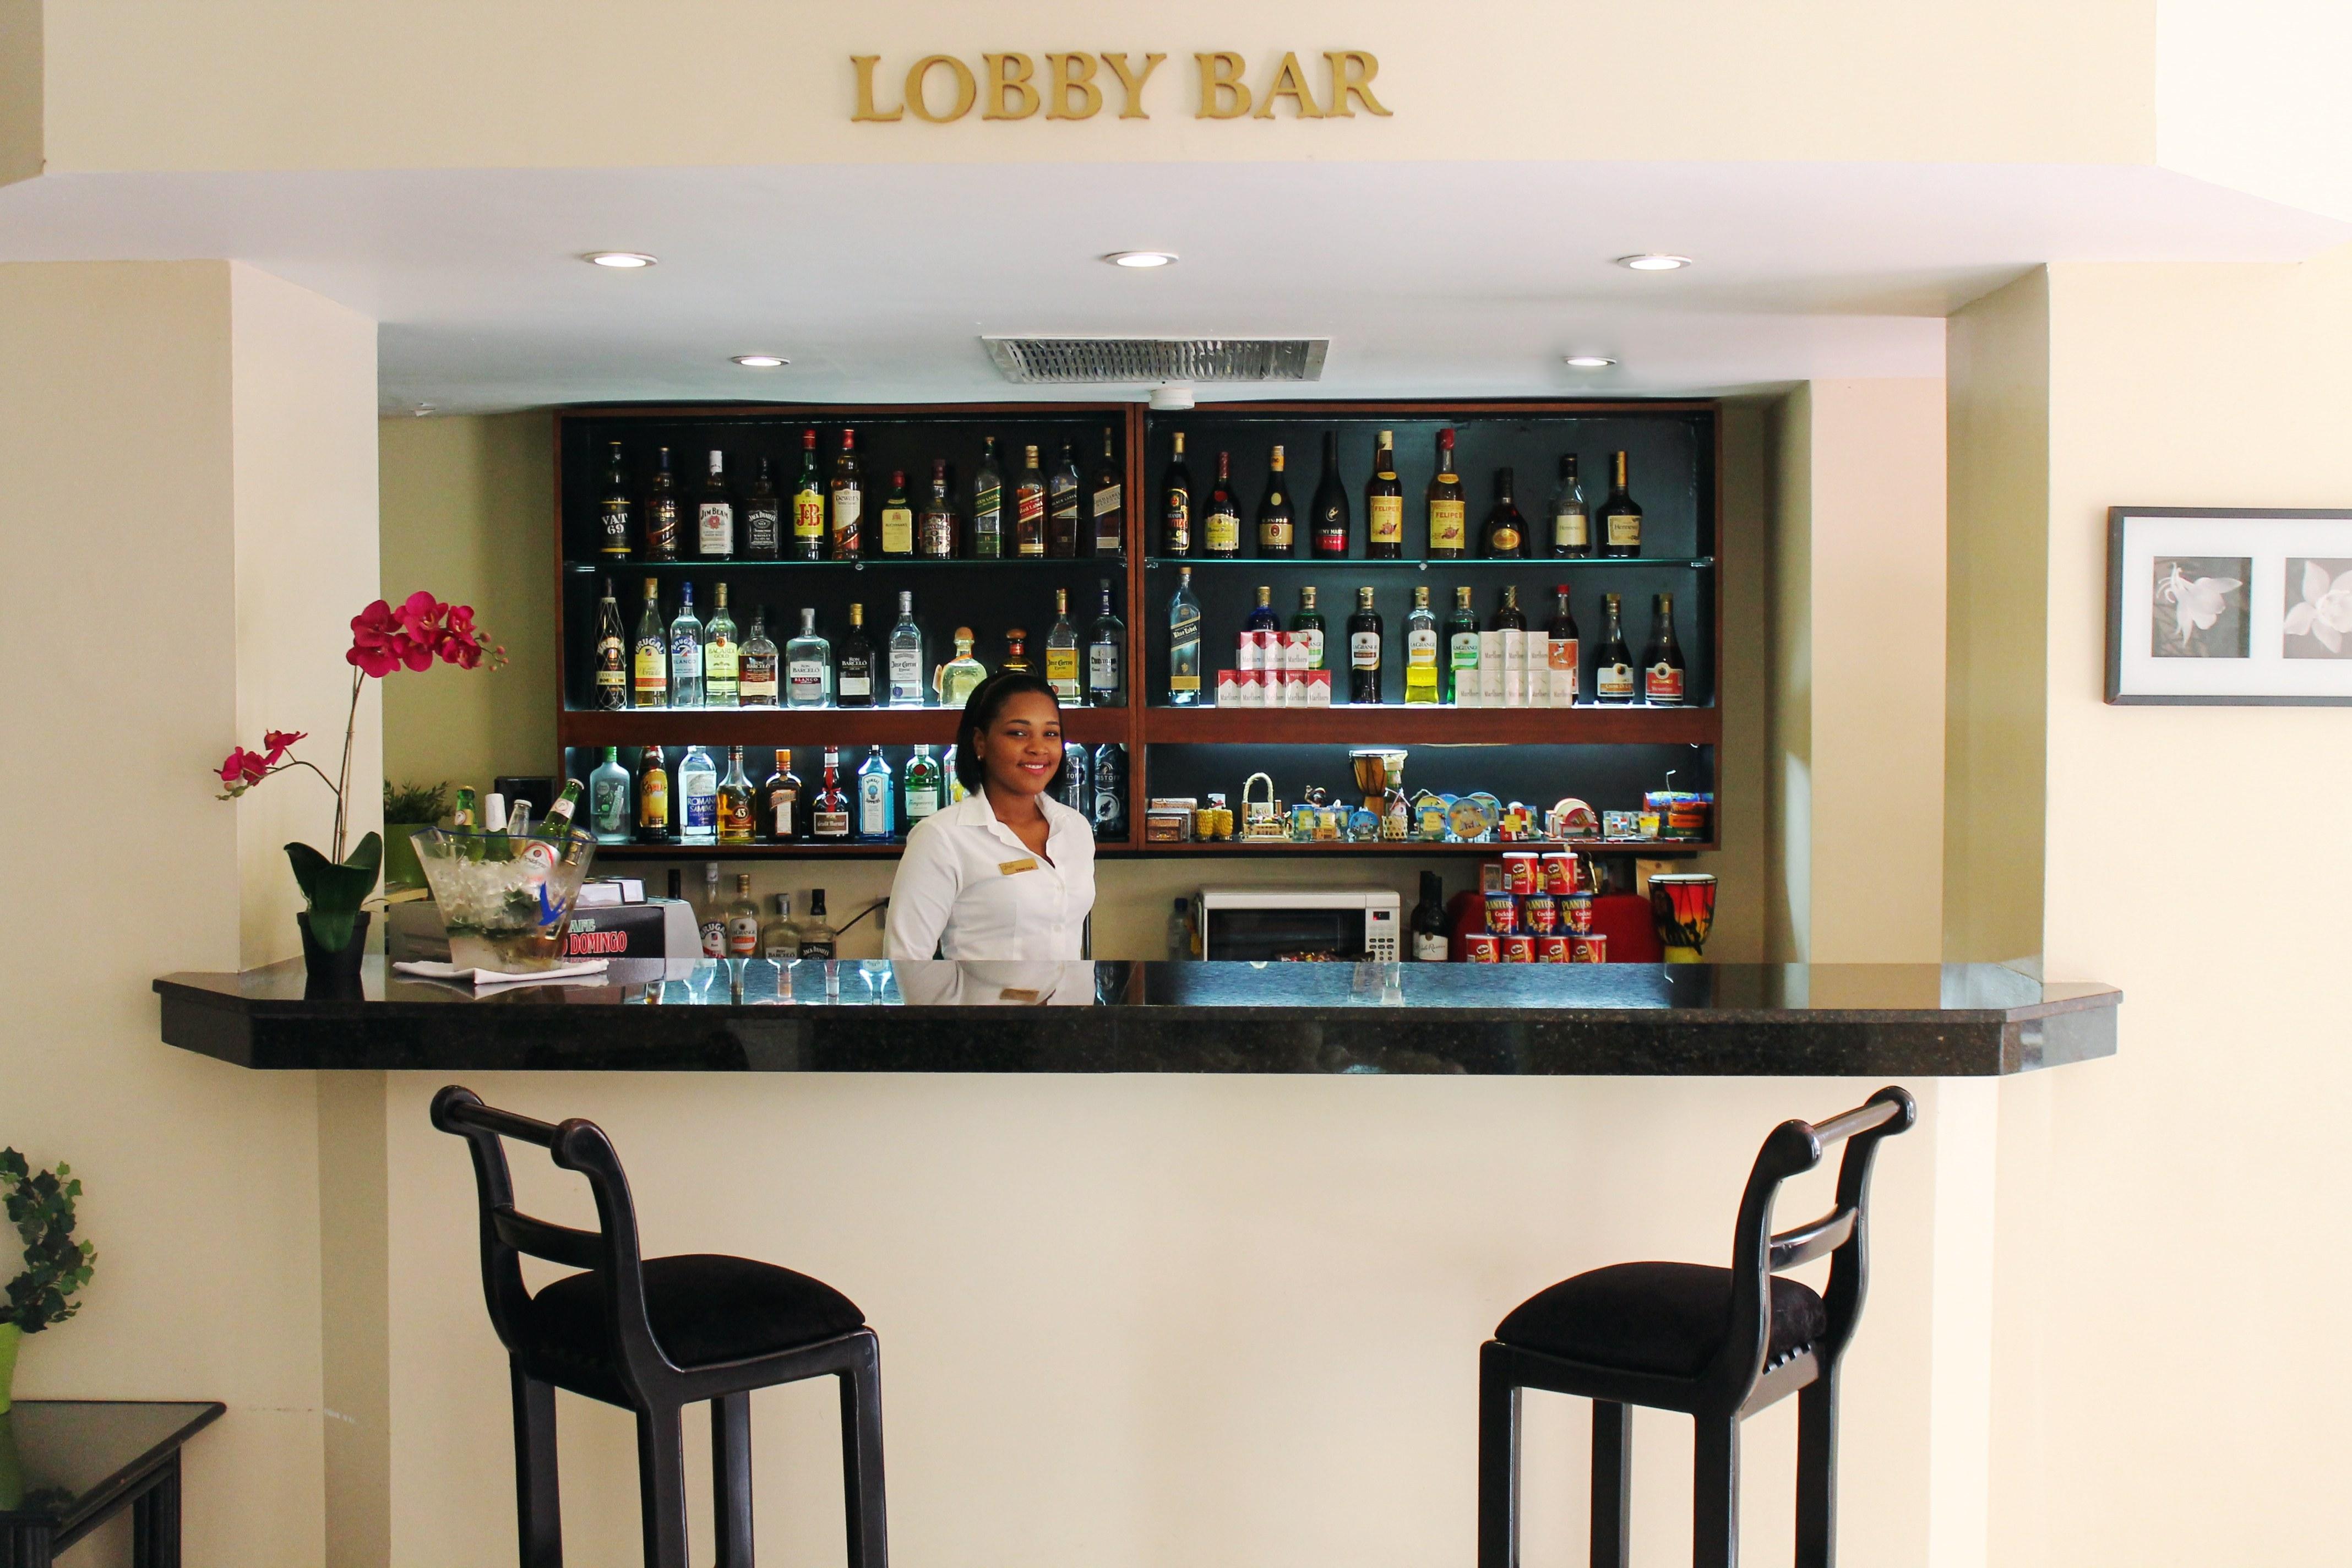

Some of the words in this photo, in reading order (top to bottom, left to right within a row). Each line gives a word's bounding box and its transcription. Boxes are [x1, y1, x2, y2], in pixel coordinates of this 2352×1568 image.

[850, 53, 1167, 123] LOBBY
[1194, 52, 1393, 119] BAR
[1029, 500, 1043, 511] Label
[601, 513, 628, 525] VAT
[700, 508, 711, 520] JIM
[712, 508, 728, 519] BEAM
[749, 513, 759, 522] JACK
[607, 524, 624, 535] 69
[1173, 629, 1185, 638] Blue
[1184, 625, 1197, 634] Label
[735, 808, 746, 818] 43
[568, 919, 596, 933] AFE
[570, 931, 627, 955] DOMINGO
